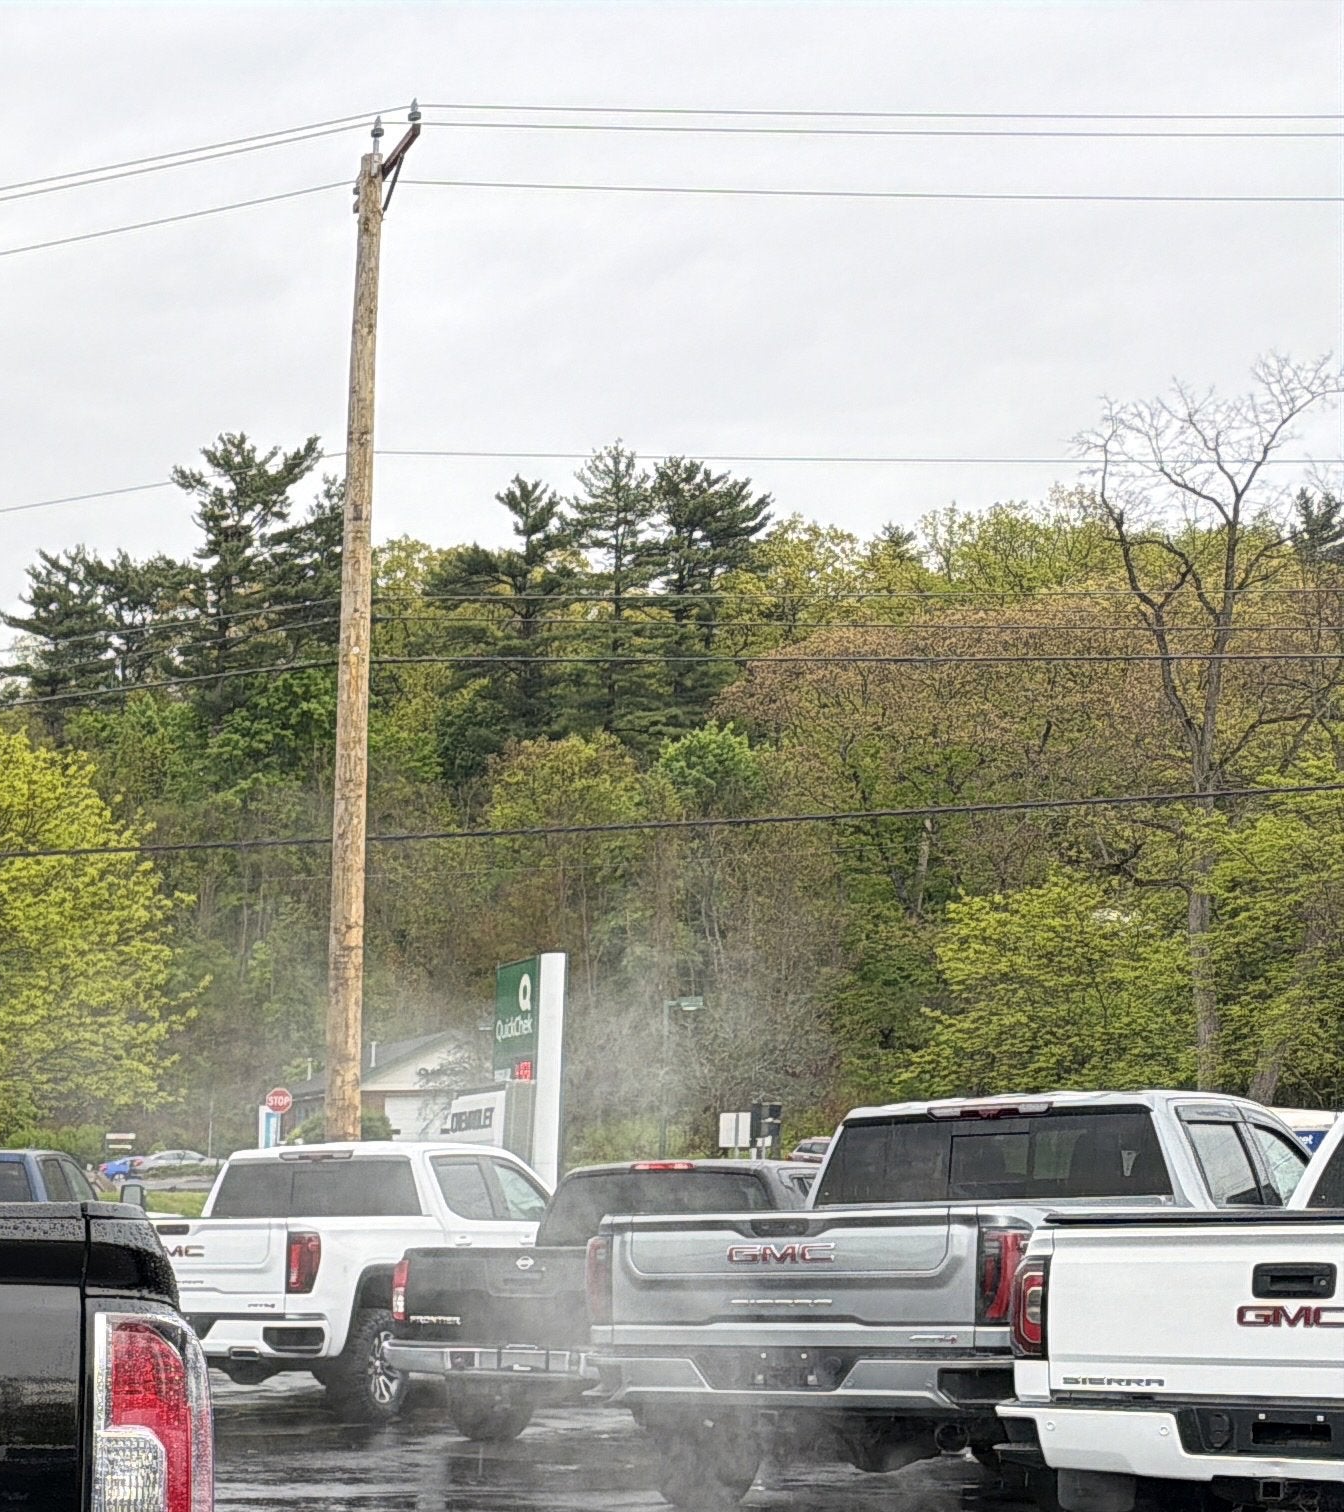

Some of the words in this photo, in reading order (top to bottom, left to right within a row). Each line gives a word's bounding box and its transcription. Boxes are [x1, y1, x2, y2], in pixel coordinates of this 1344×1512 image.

[268, 1095, 290, 1107] STOP
[163, 1245, 205, 1258] MC
[727, 1243, 836, 1264] GMC
[1237, 1305, 1344, 1328] GMC
[1062, 1376, 1166, 1387] SIERRA
